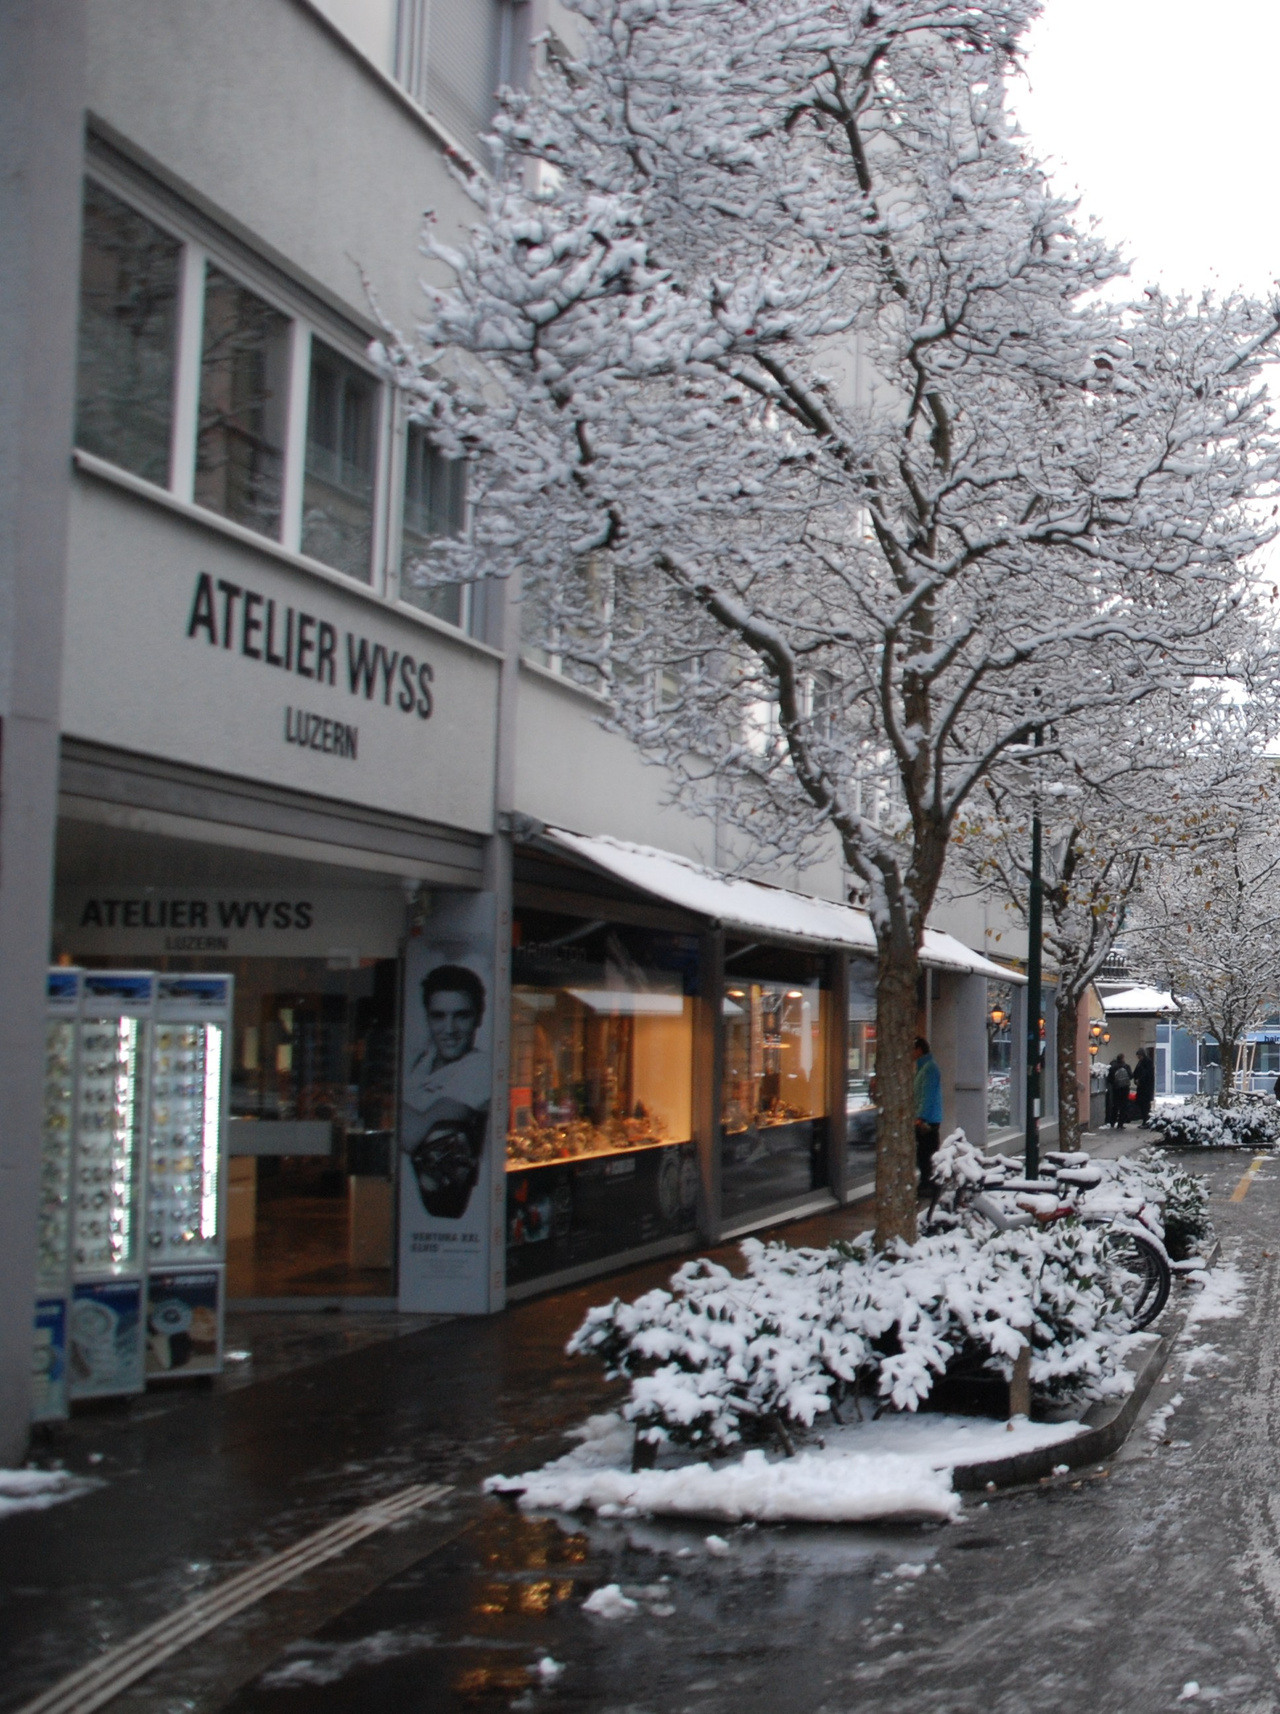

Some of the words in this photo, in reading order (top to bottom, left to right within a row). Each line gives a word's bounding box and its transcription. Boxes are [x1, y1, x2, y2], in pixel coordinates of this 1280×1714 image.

[188, 571, 338, 687] ATELIER
[347, 632, 434, 721] WYSS
[285, 706, 359, 761] LUZERN
[80, 900, 208, 928] ATELIER
[218, 901, 314, 930] WYSS
[165, 936, 229, 950] LUZERN
